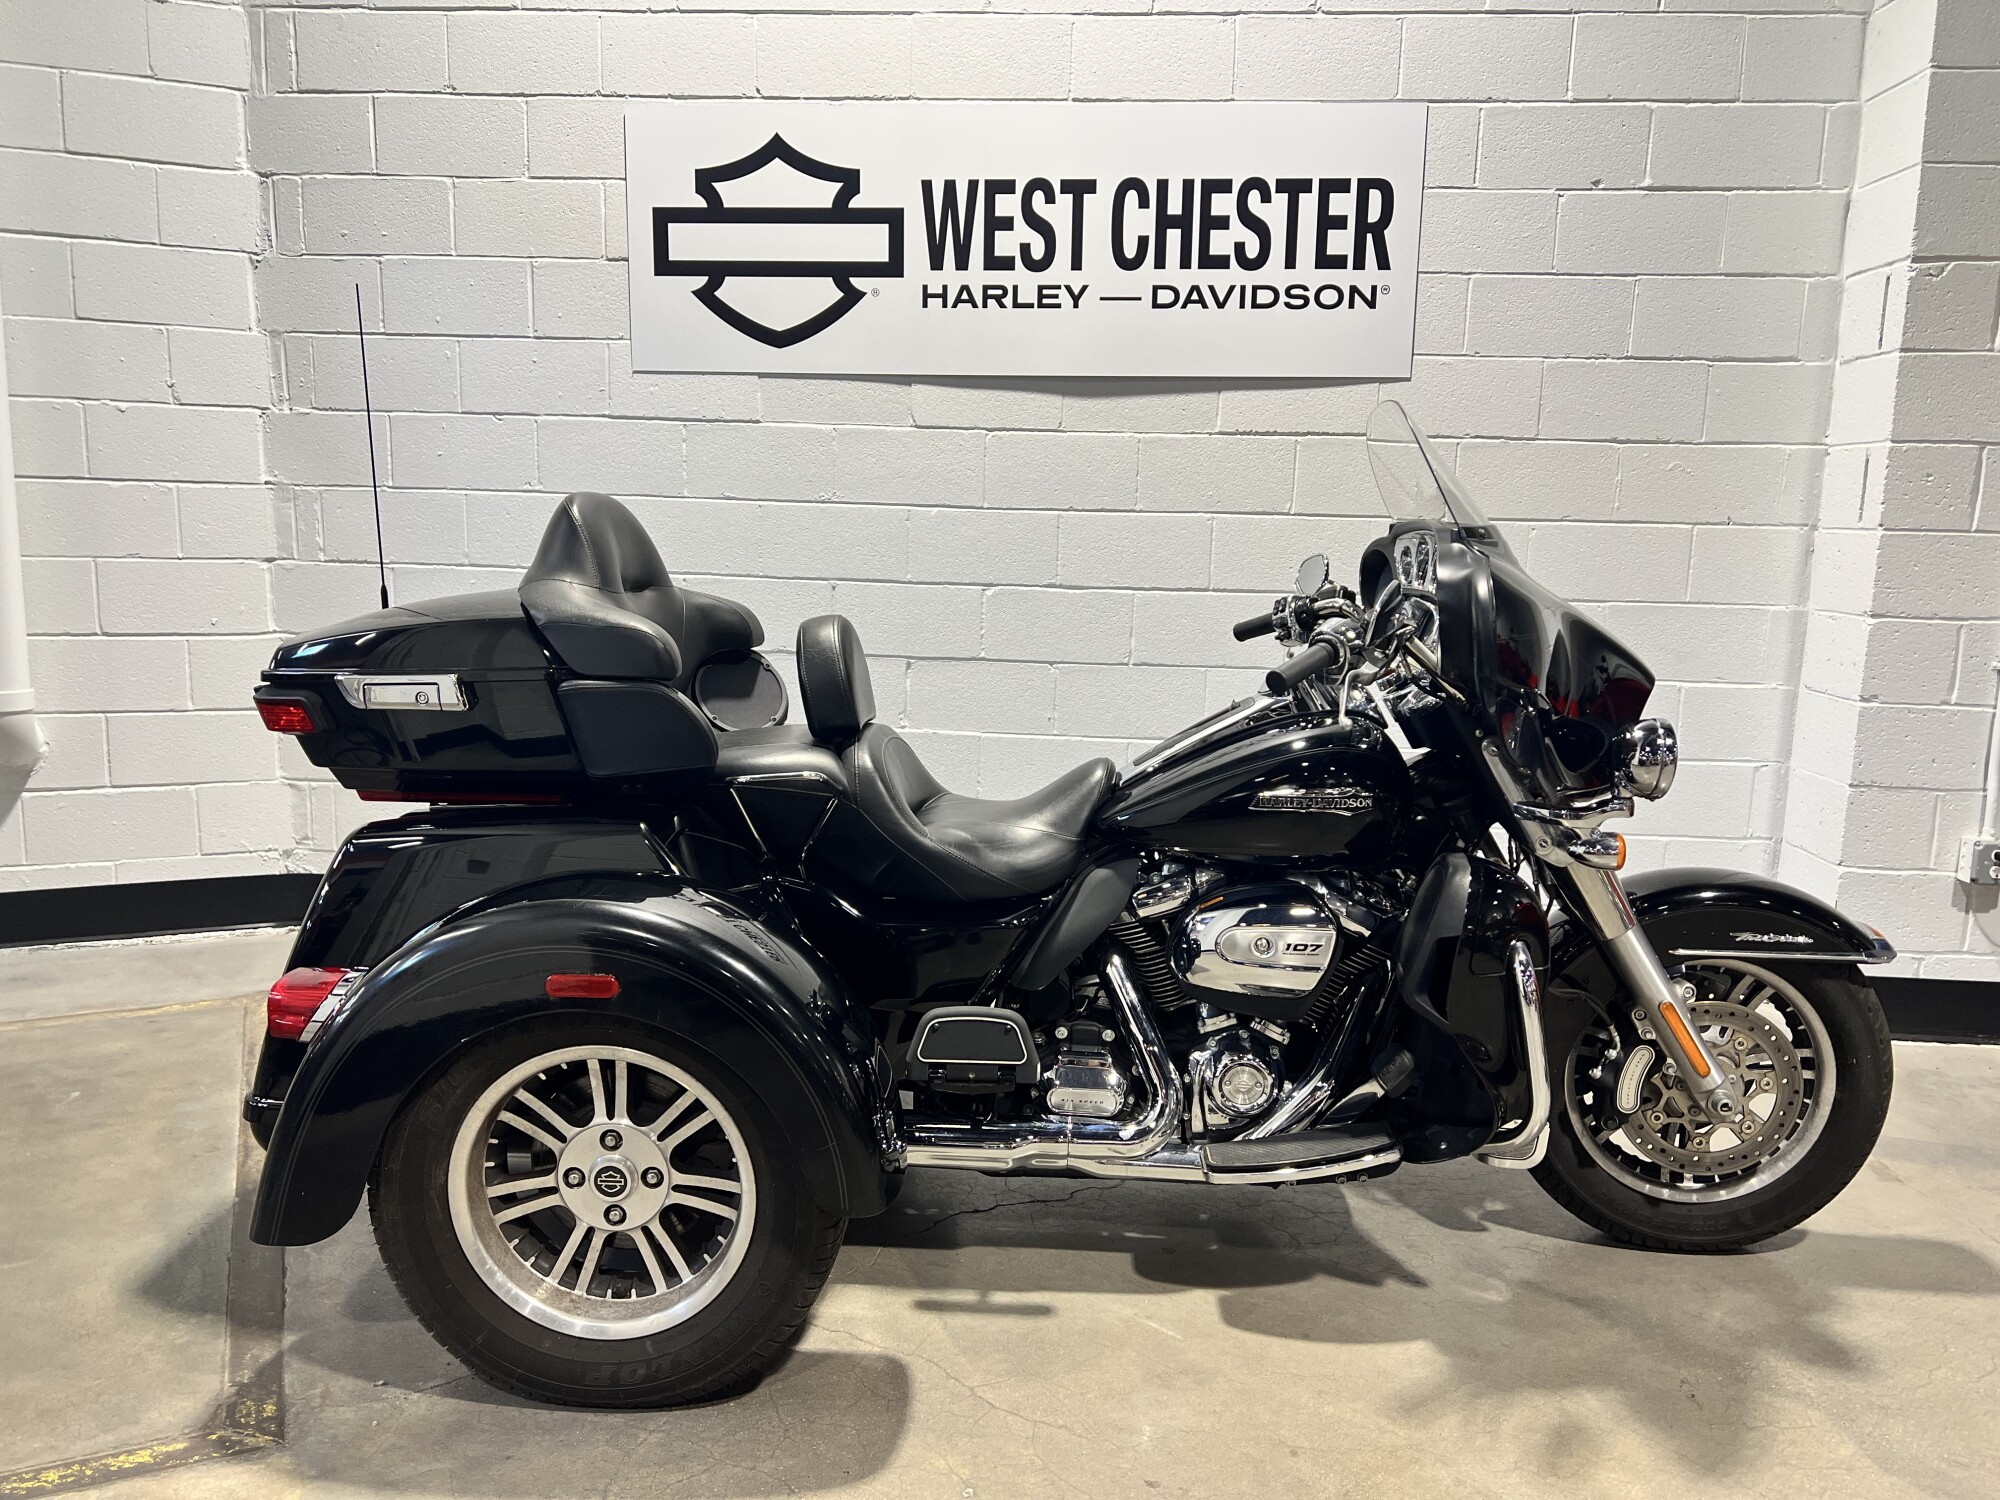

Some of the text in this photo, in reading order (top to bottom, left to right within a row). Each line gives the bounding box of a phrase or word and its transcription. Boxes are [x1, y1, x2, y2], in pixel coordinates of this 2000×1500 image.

[921, 177, 1394, 272] WEST CHESTER
[922, 284, 1089, 308] HARLEY
[1285, 943, 1323, 952] 107
